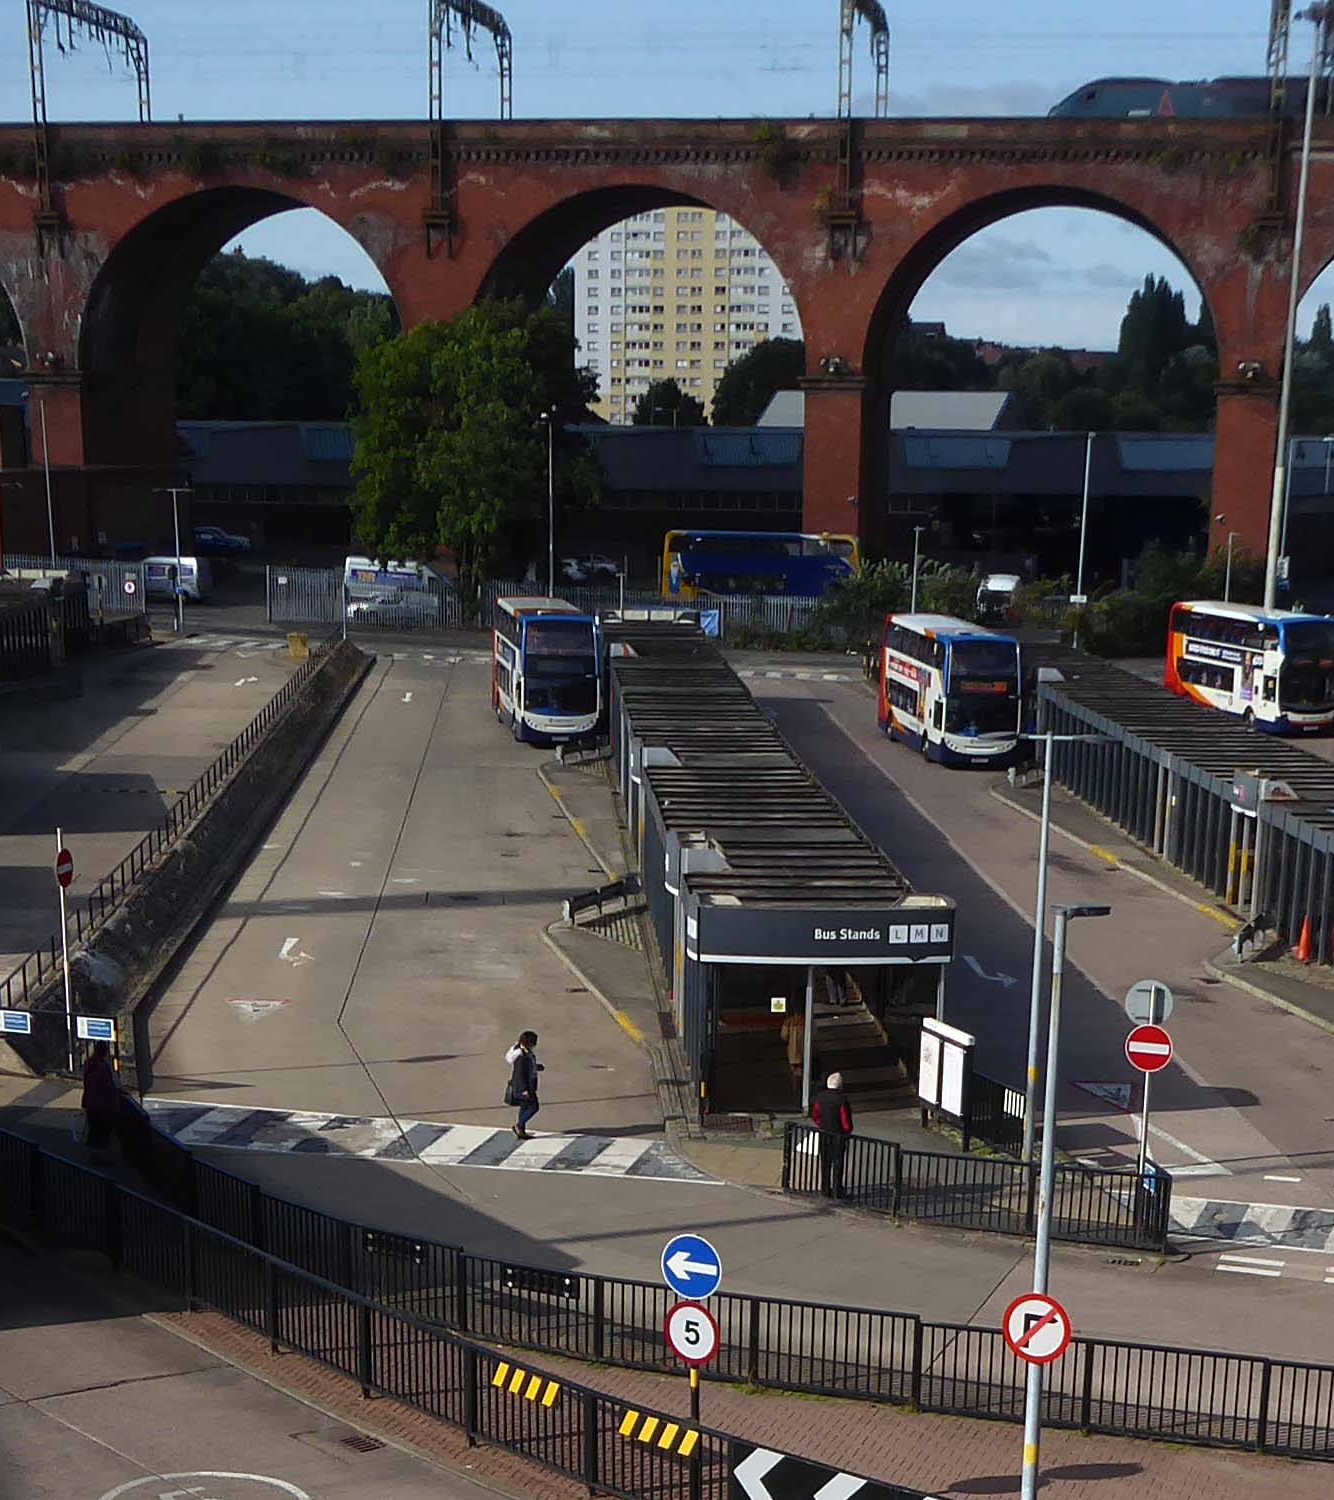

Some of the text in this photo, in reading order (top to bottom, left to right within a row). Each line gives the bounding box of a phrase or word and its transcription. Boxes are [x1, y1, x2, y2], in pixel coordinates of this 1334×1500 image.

[814, 928, 944, 940] Bus Stands L M N
[684, 1320, 700, 1346] 5
